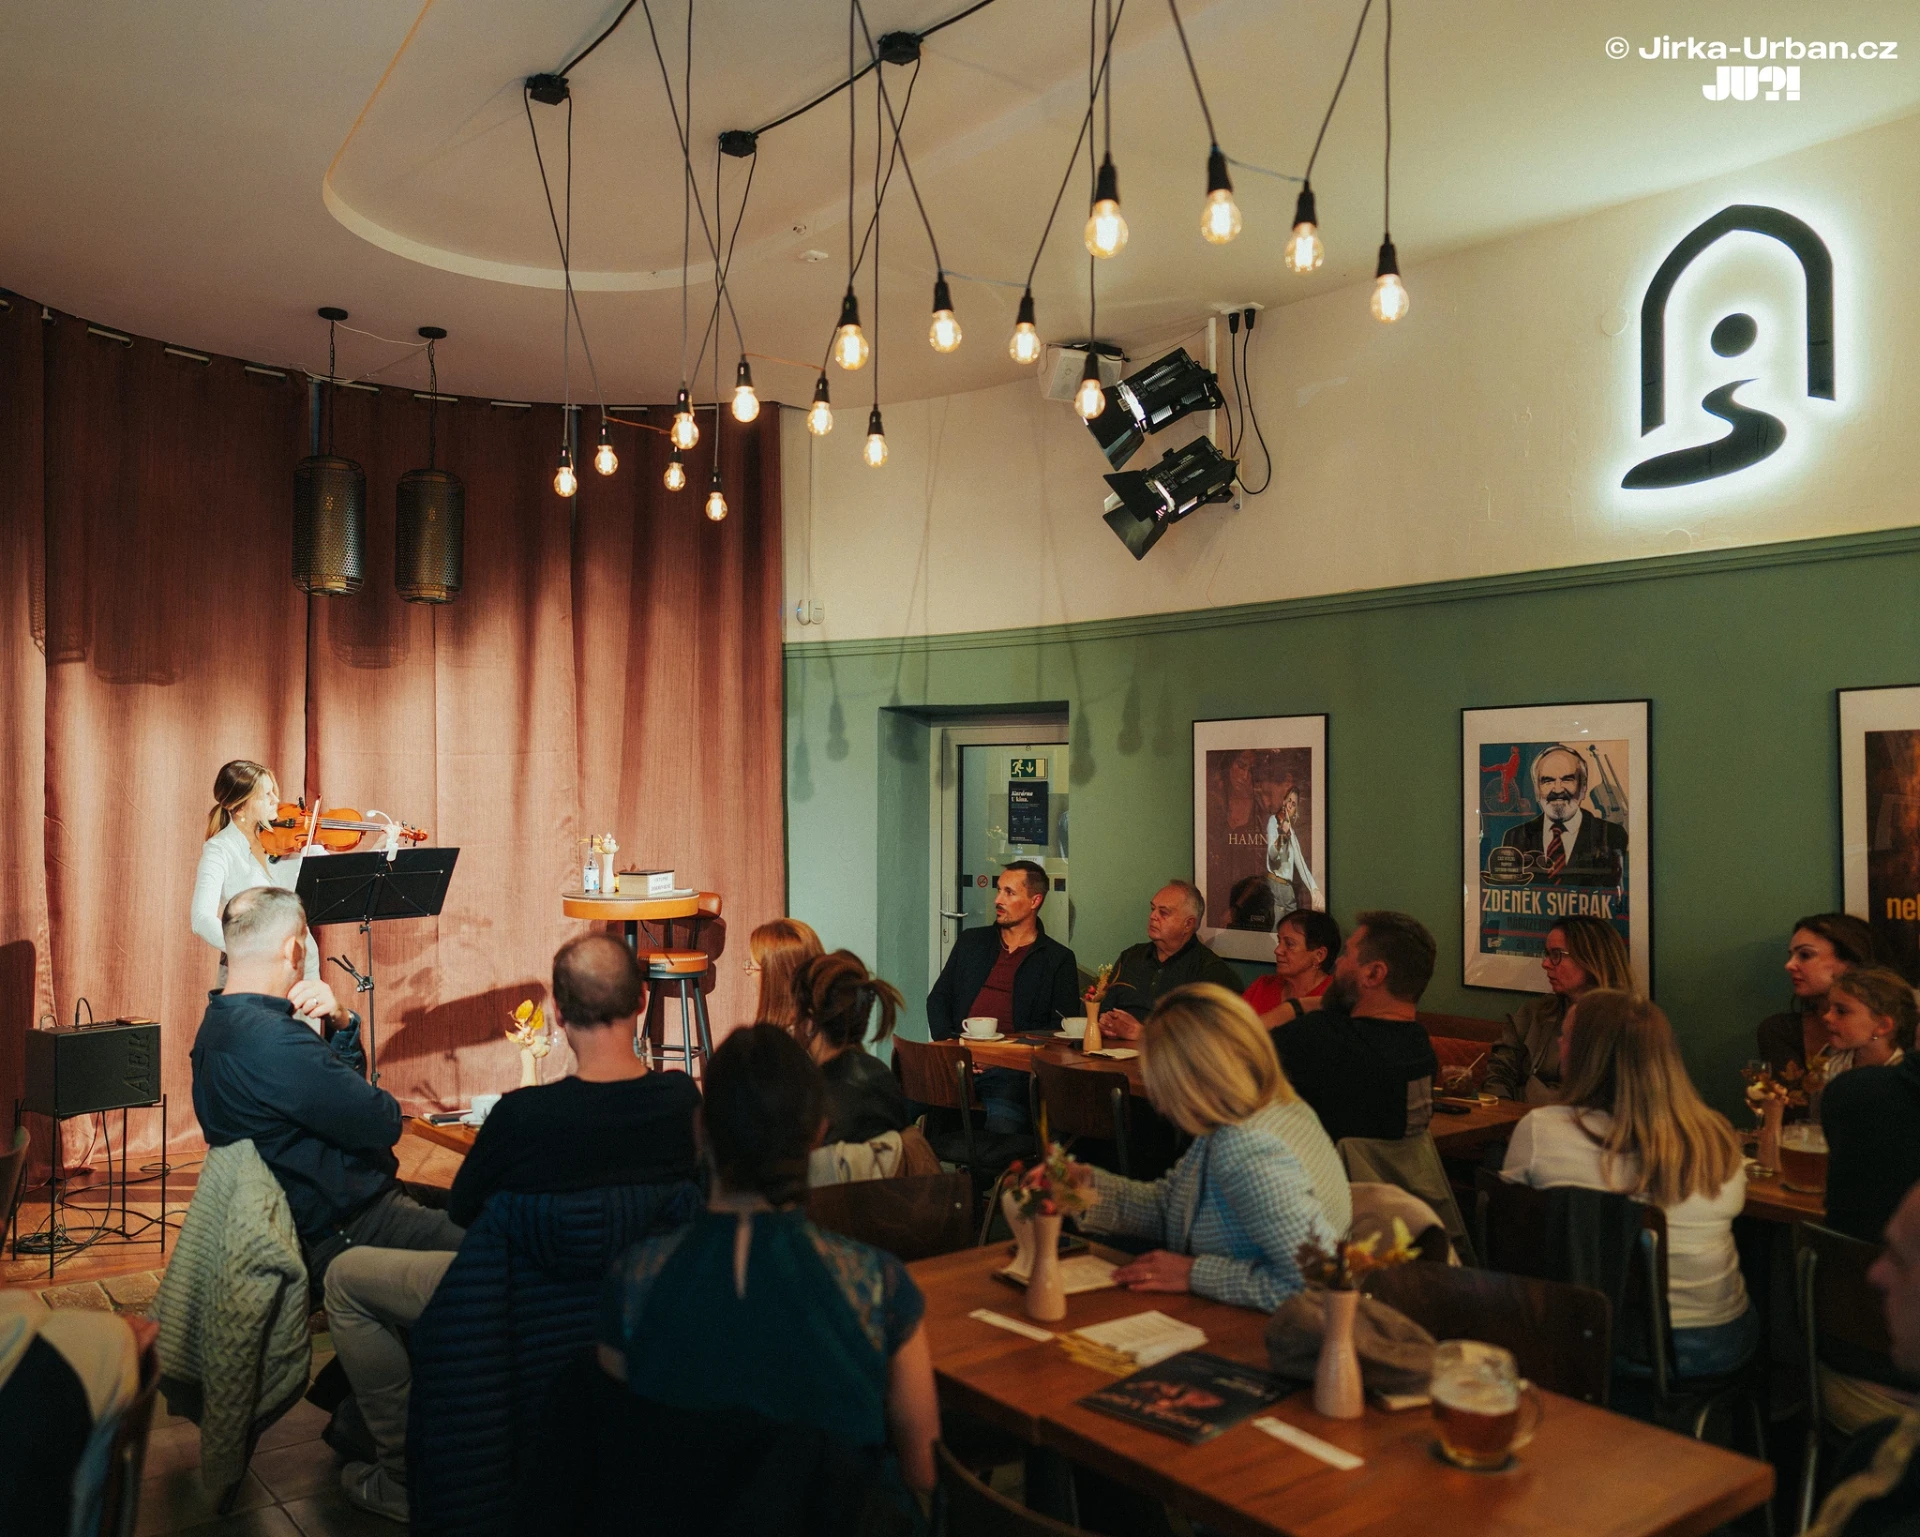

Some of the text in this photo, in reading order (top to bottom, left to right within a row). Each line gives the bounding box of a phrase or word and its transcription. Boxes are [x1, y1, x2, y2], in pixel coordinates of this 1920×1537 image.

[1482, 888, 1542, 915] ZDENĚK
[1546, 889, 1613, 920] SVĚRÁK
[122, 1033, 151, 1095] AER
